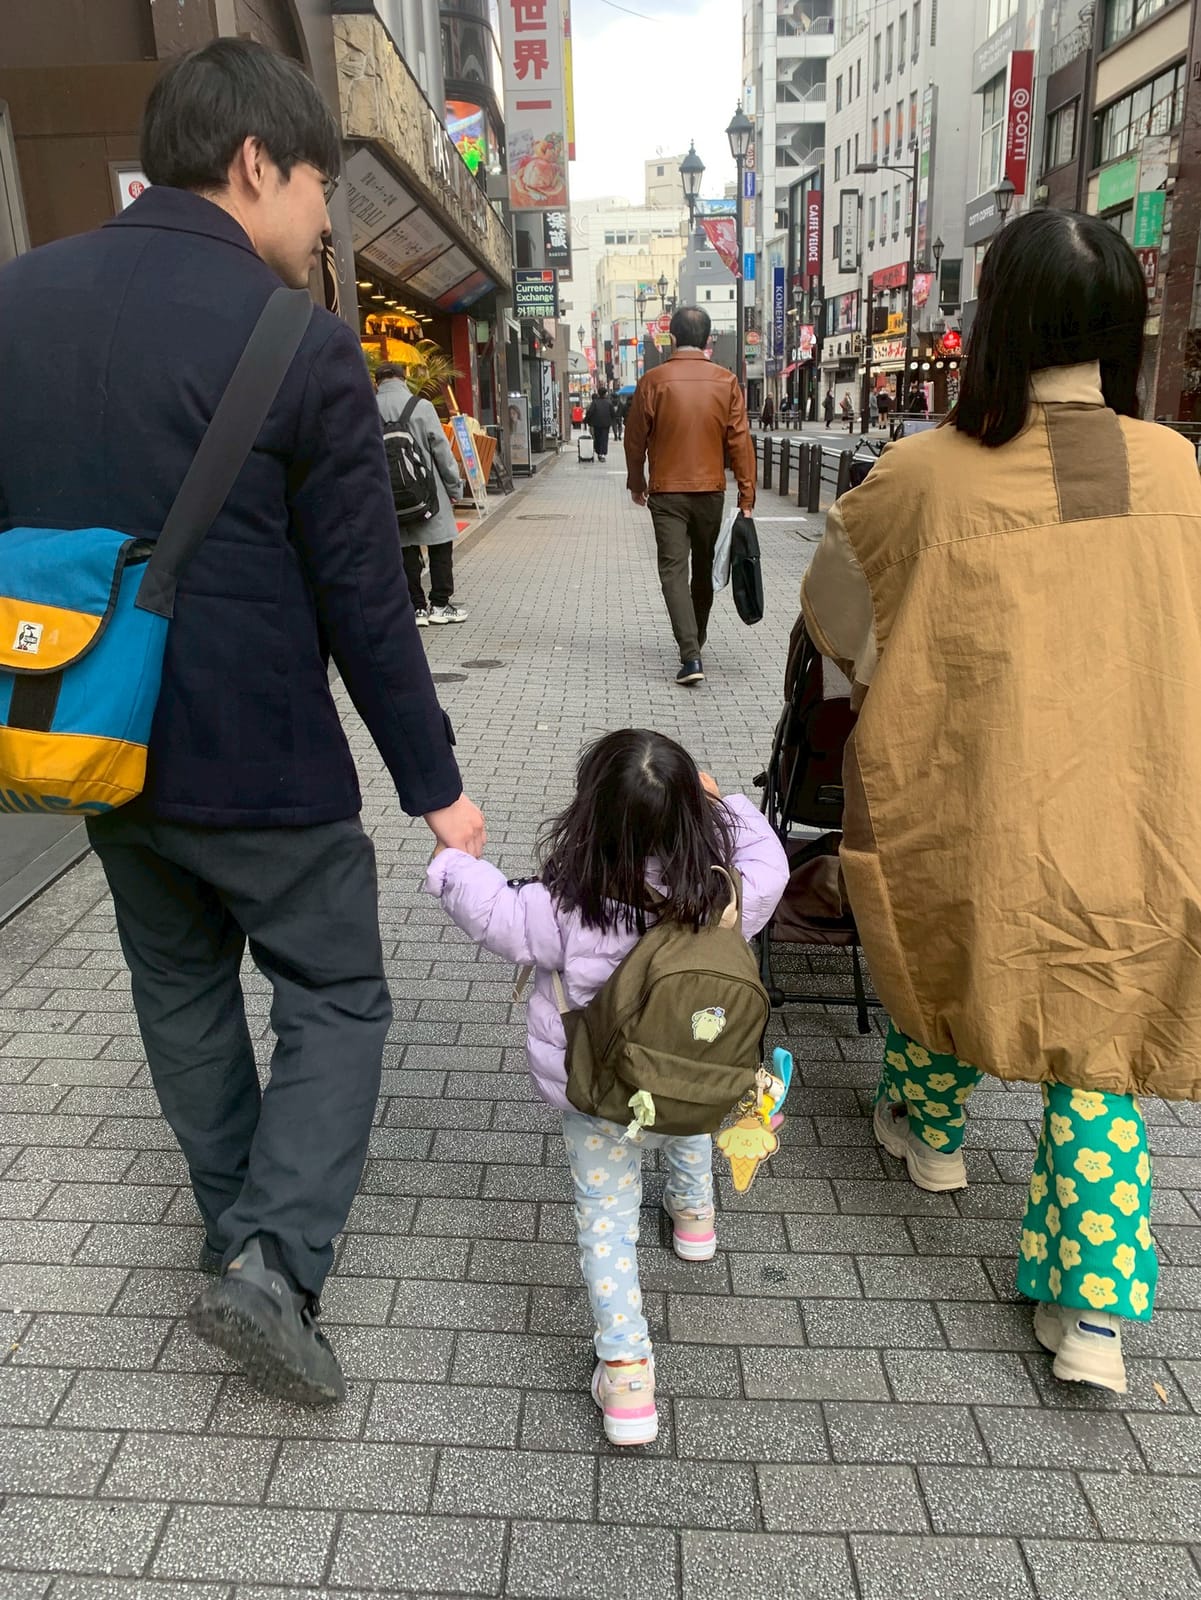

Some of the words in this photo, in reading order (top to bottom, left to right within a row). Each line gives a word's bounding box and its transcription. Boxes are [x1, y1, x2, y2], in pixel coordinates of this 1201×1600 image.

[510, 0, 552, 110] 世界一
[1014, 111, 1029, 160] COTTI
[808, 204, 819, 230] CAFFE
[980, 204, 995, 221] COFFEE
[546, 212, 568, 249] 楽蔵
[808, 231, 819, 262] VELOCE
[515, 284, 554, 295] Currency
[516, 293, 554, 303] Exchange
[517, 305, 555, 317] 外貨両替
[775, 286, 784, 338] KOMEHYO
